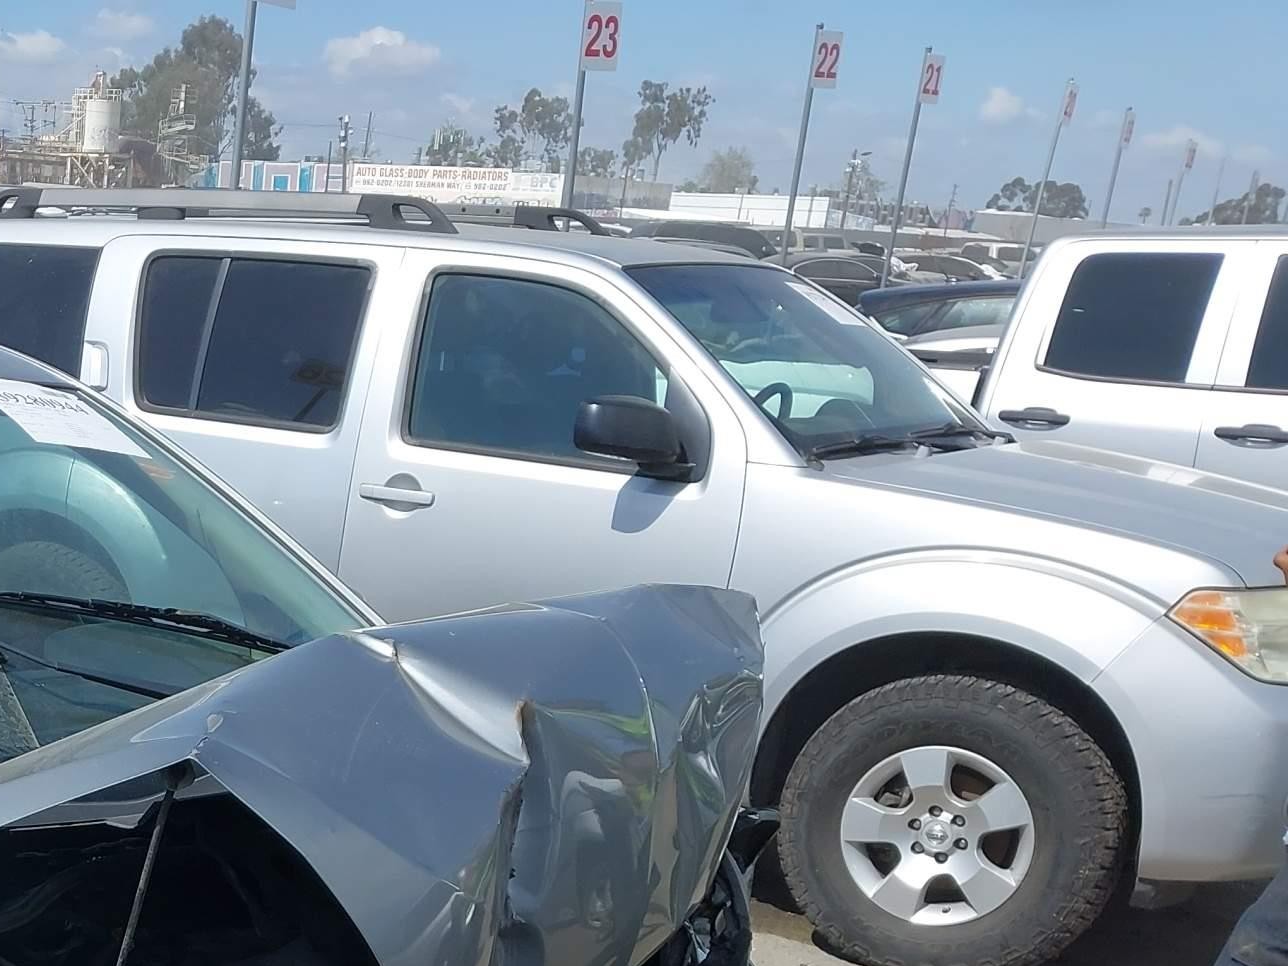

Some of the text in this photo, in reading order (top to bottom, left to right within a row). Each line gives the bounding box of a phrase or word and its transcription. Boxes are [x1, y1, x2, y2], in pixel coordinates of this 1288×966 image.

[585, 14, 619, 58] 23
[814, 42, 840, 79] 22
[922, 63, 942, 96] 21
[356, 166, 377, 177] AUTO
